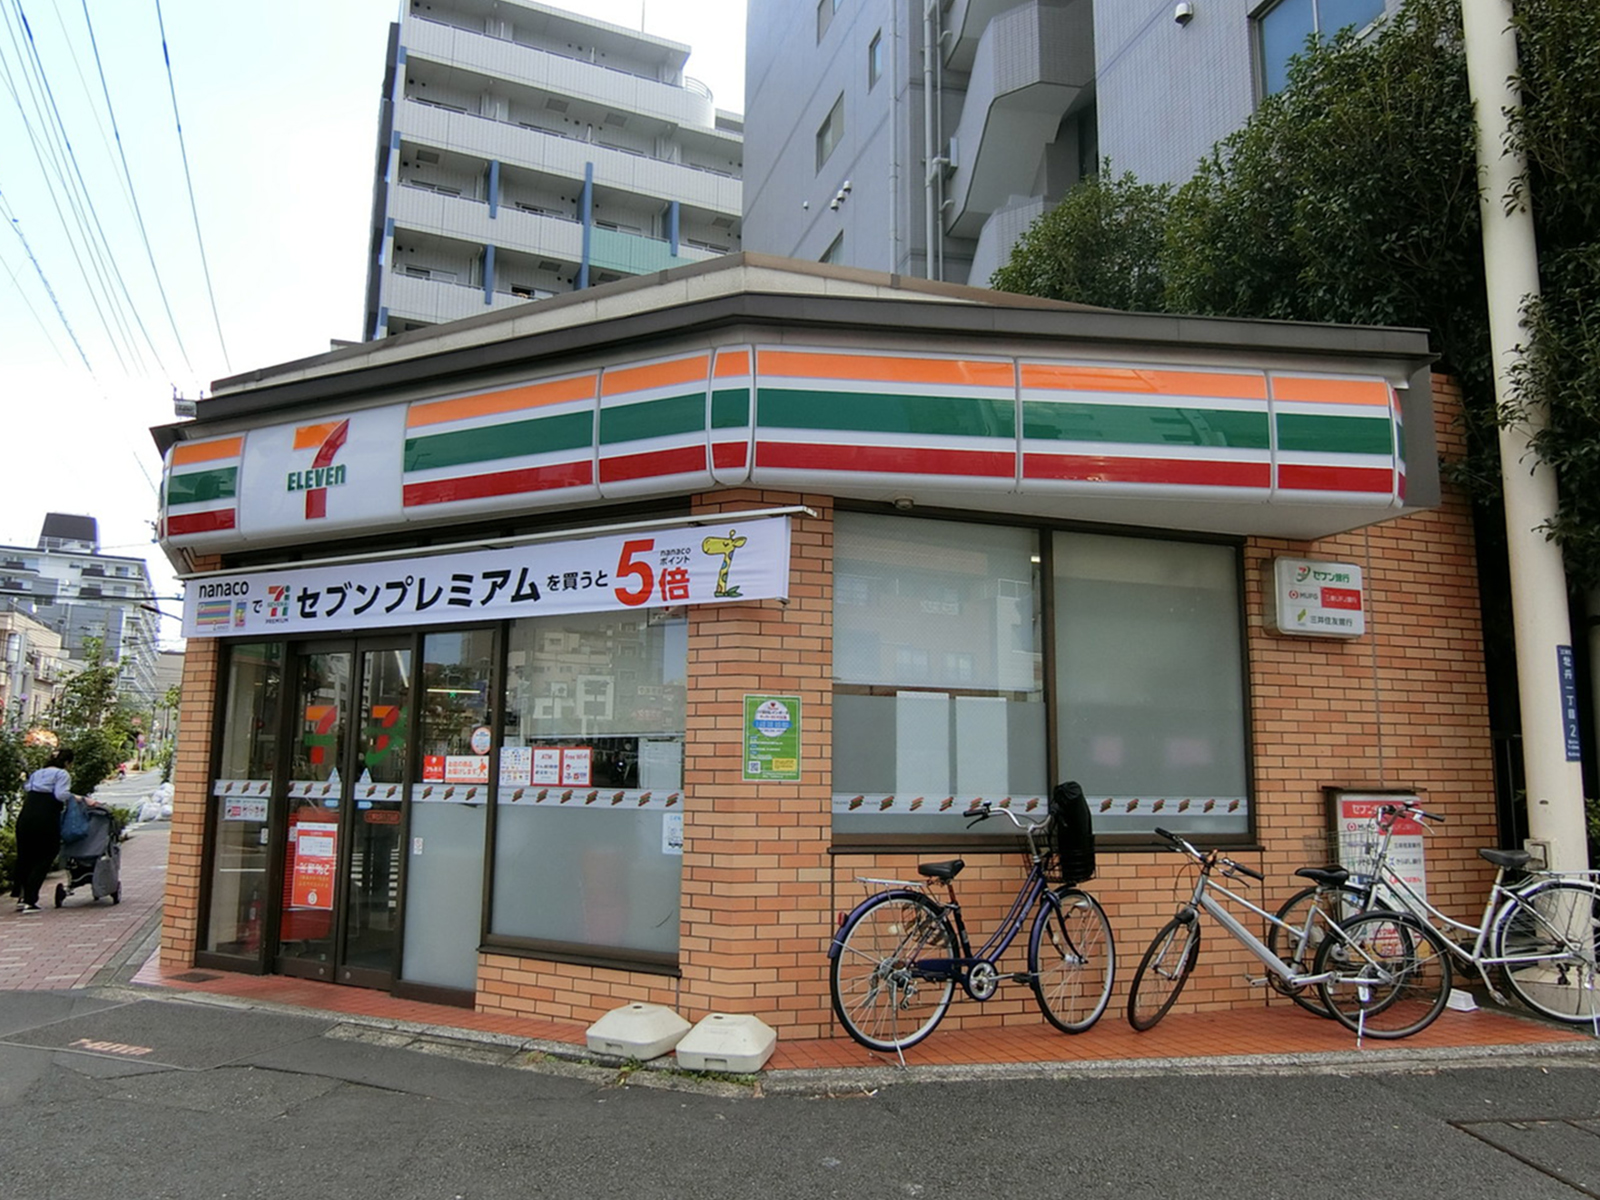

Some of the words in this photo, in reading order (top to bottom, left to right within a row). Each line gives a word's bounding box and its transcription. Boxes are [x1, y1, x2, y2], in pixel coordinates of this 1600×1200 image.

[659, 546, 692, 558] nanaco
[659, 556, 691, 566] ポイント
[297, 567, 541, 620] セブンプレミアム
[546, 569, 609, 592] を買うと
[614, 538, 656, 607] 5
[658, 567, 691, 602] 倍
[1312, 570, 1350, 583] セブン銀行
[198, 581, 250, 598] nanaco
[1300, 591, 1319, 600] MUFG
[1309, 615, 1353, 627] 三井住友銀行
